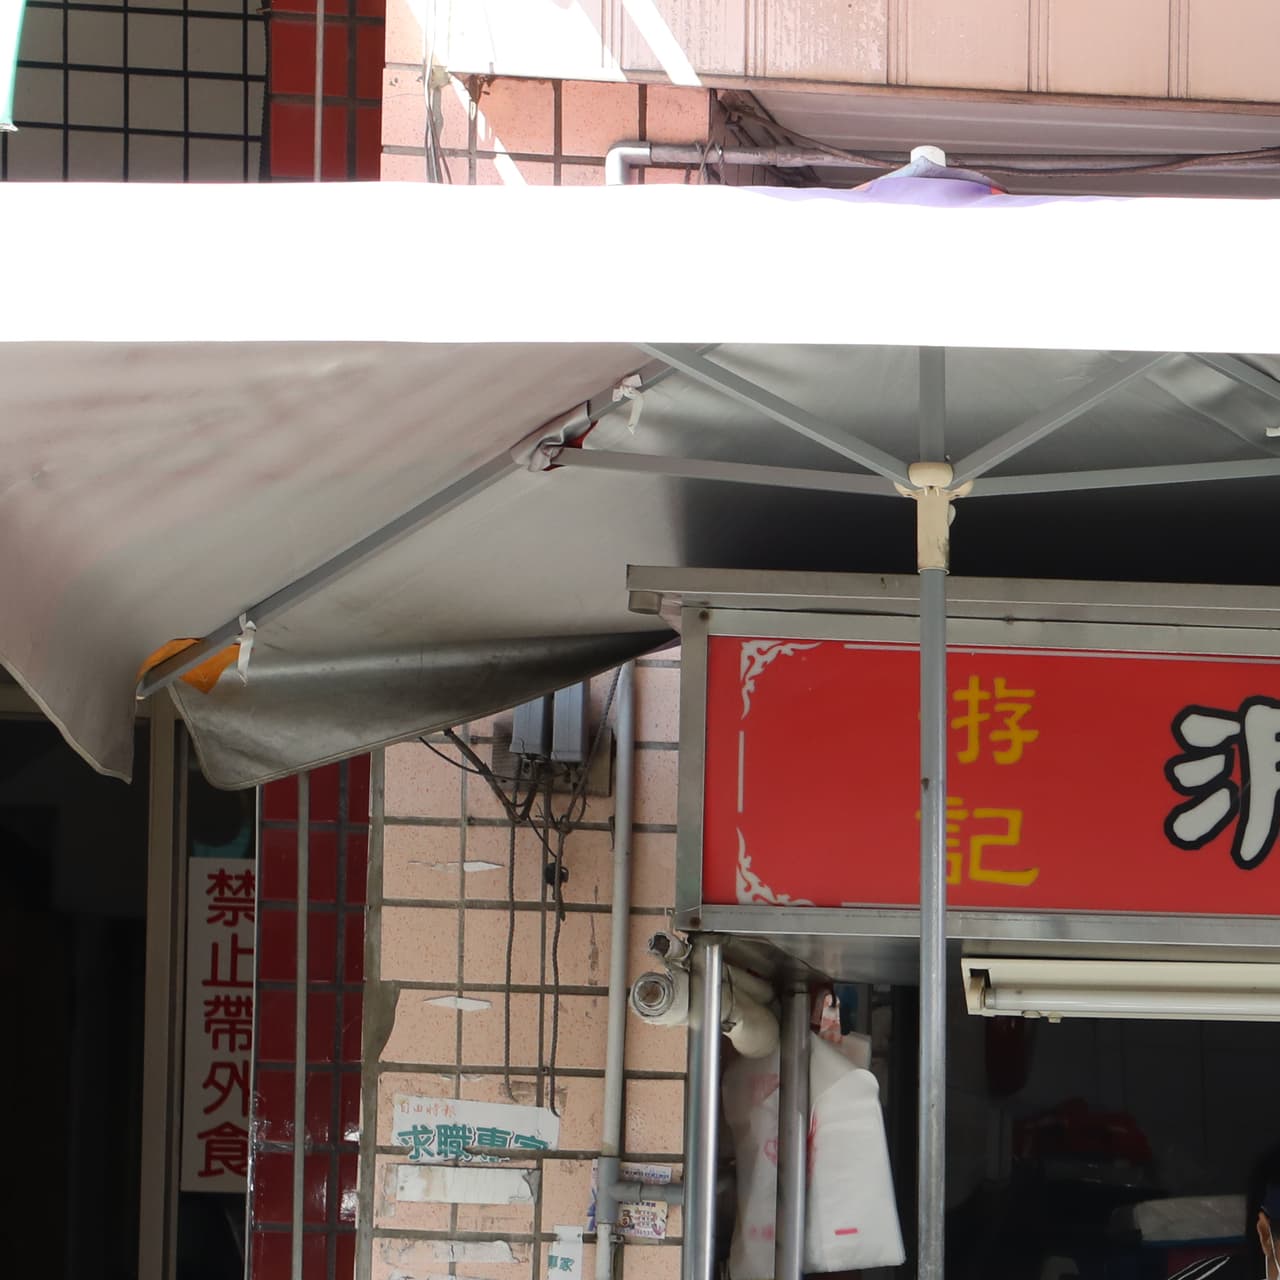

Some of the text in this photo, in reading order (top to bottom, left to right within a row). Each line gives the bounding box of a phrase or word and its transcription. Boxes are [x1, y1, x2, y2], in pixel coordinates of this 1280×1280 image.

[197, 867, 256, 1179] 禁止帶外食
